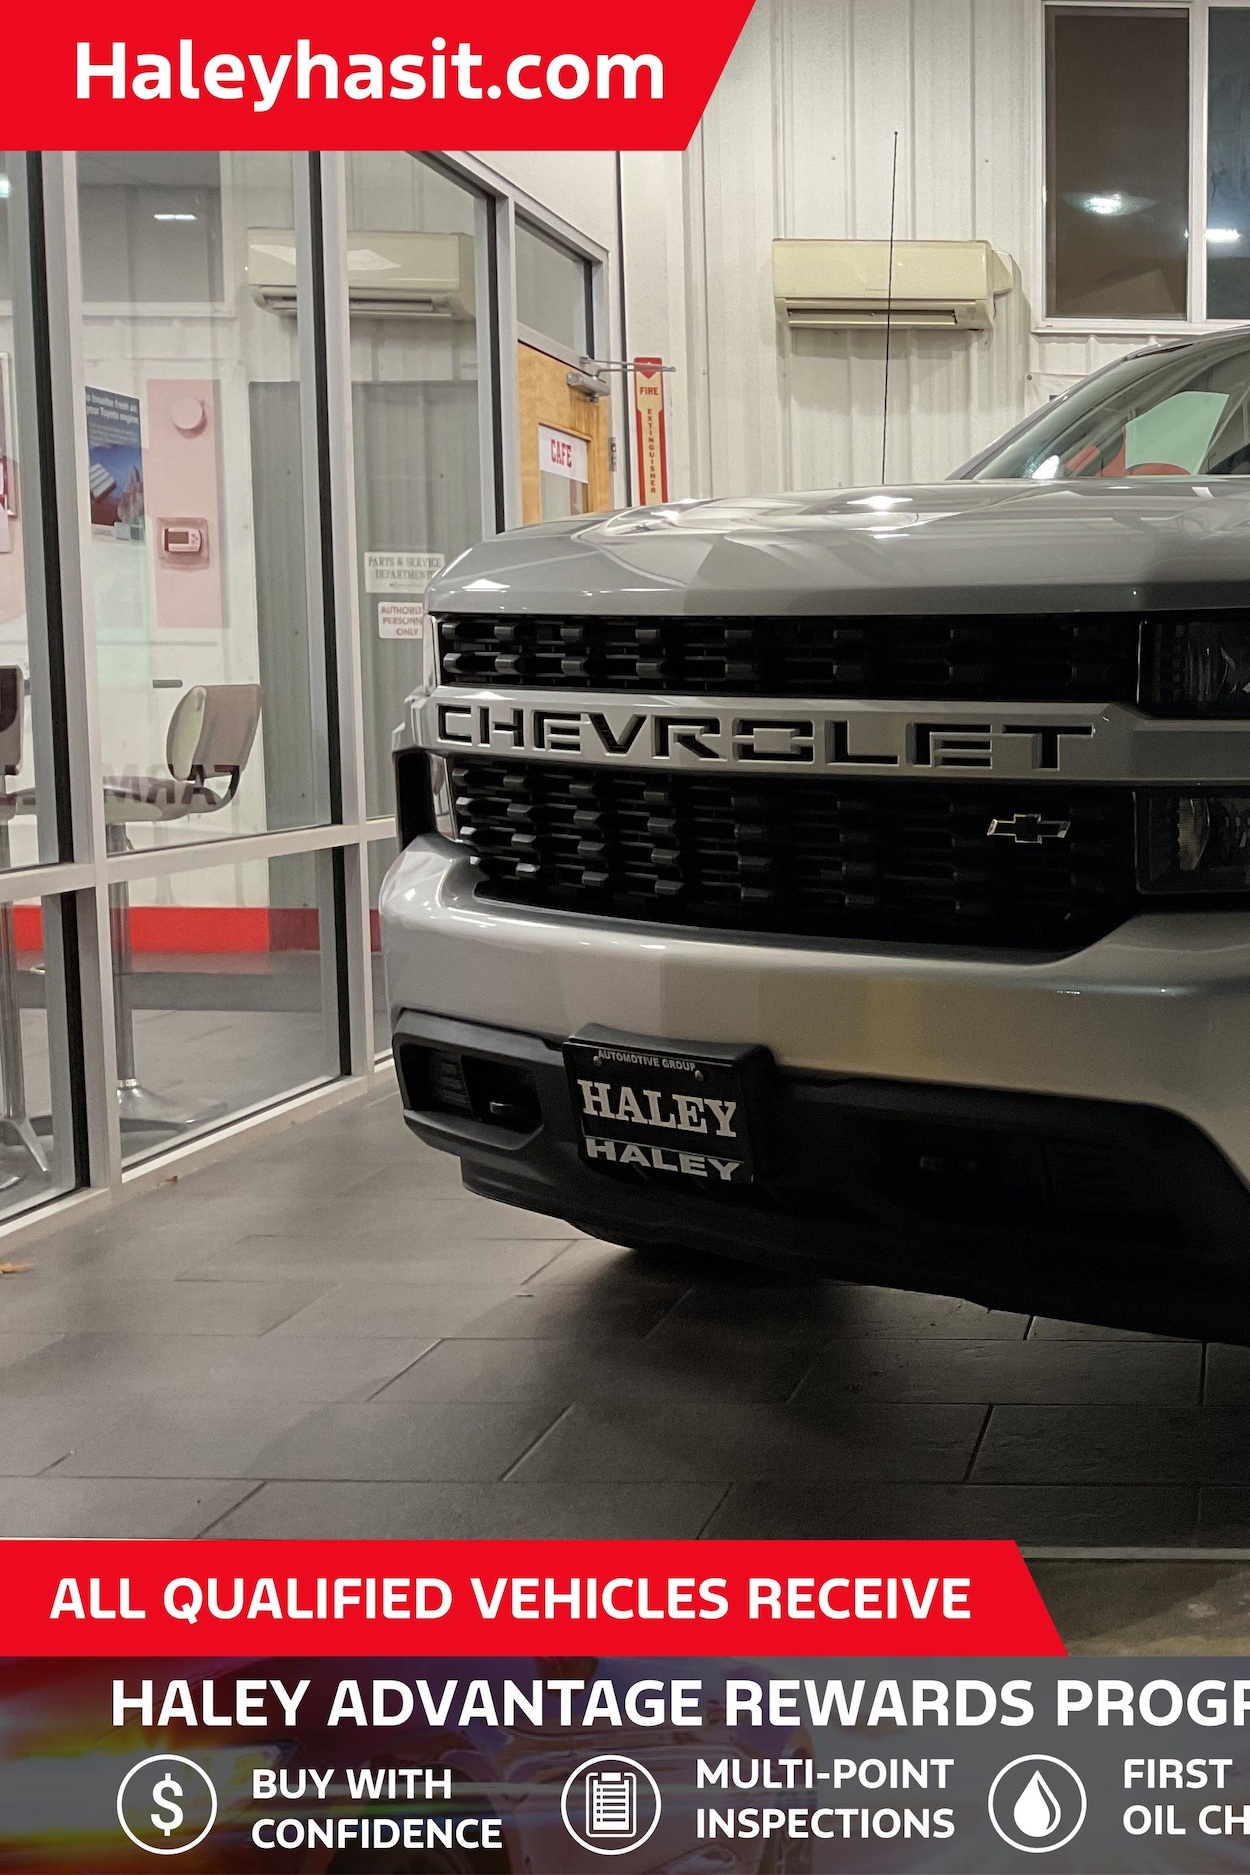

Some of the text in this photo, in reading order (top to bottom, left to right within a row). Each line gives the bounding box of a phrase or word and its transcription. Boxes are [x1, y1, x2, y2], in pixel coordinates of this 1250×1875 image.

[640, 387, 658, 395] FIRE
[551, 439, 572, 468] CAFE
[647, 409, 656, 493] EXTINGUISHER
[368, 557, 442, 567] PARTS & SERVICE
[396, 628, 418, 636] ONLY
[436, 704, 1096, 772] CHEVROLET
[598, 1049, 696, 1072] AUTOMOTIVE GROUP
[577, 1078, 738, 1138] HALEY
[585, 1137, 742, 1182] HALEY
